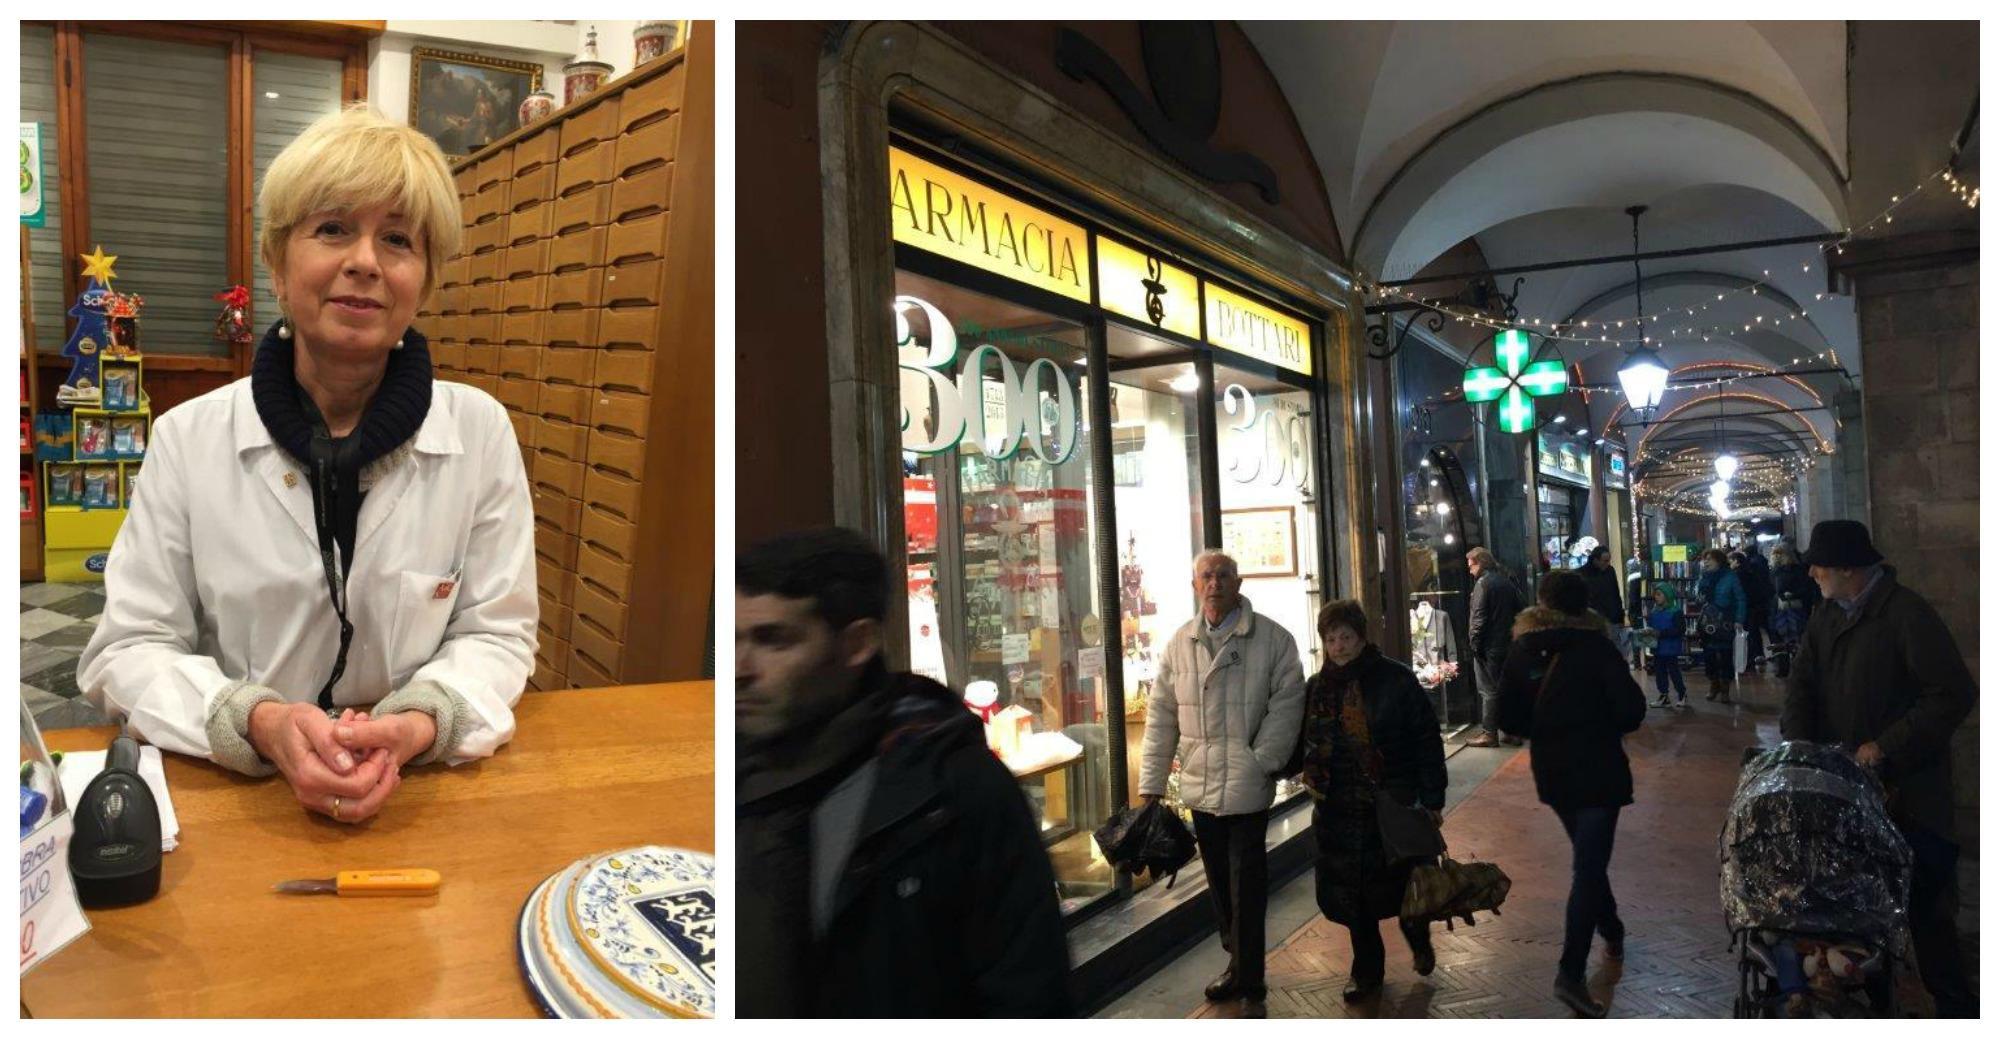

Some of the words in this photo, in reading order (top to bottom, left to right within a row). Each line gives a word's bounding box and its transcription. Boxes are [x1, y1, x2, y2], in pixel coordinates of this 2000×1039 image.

[1216, 299, 1300, 363] BOTTARI
[894, 295, 1077, 466] 300
[20, 835, 56, 876] BRA
